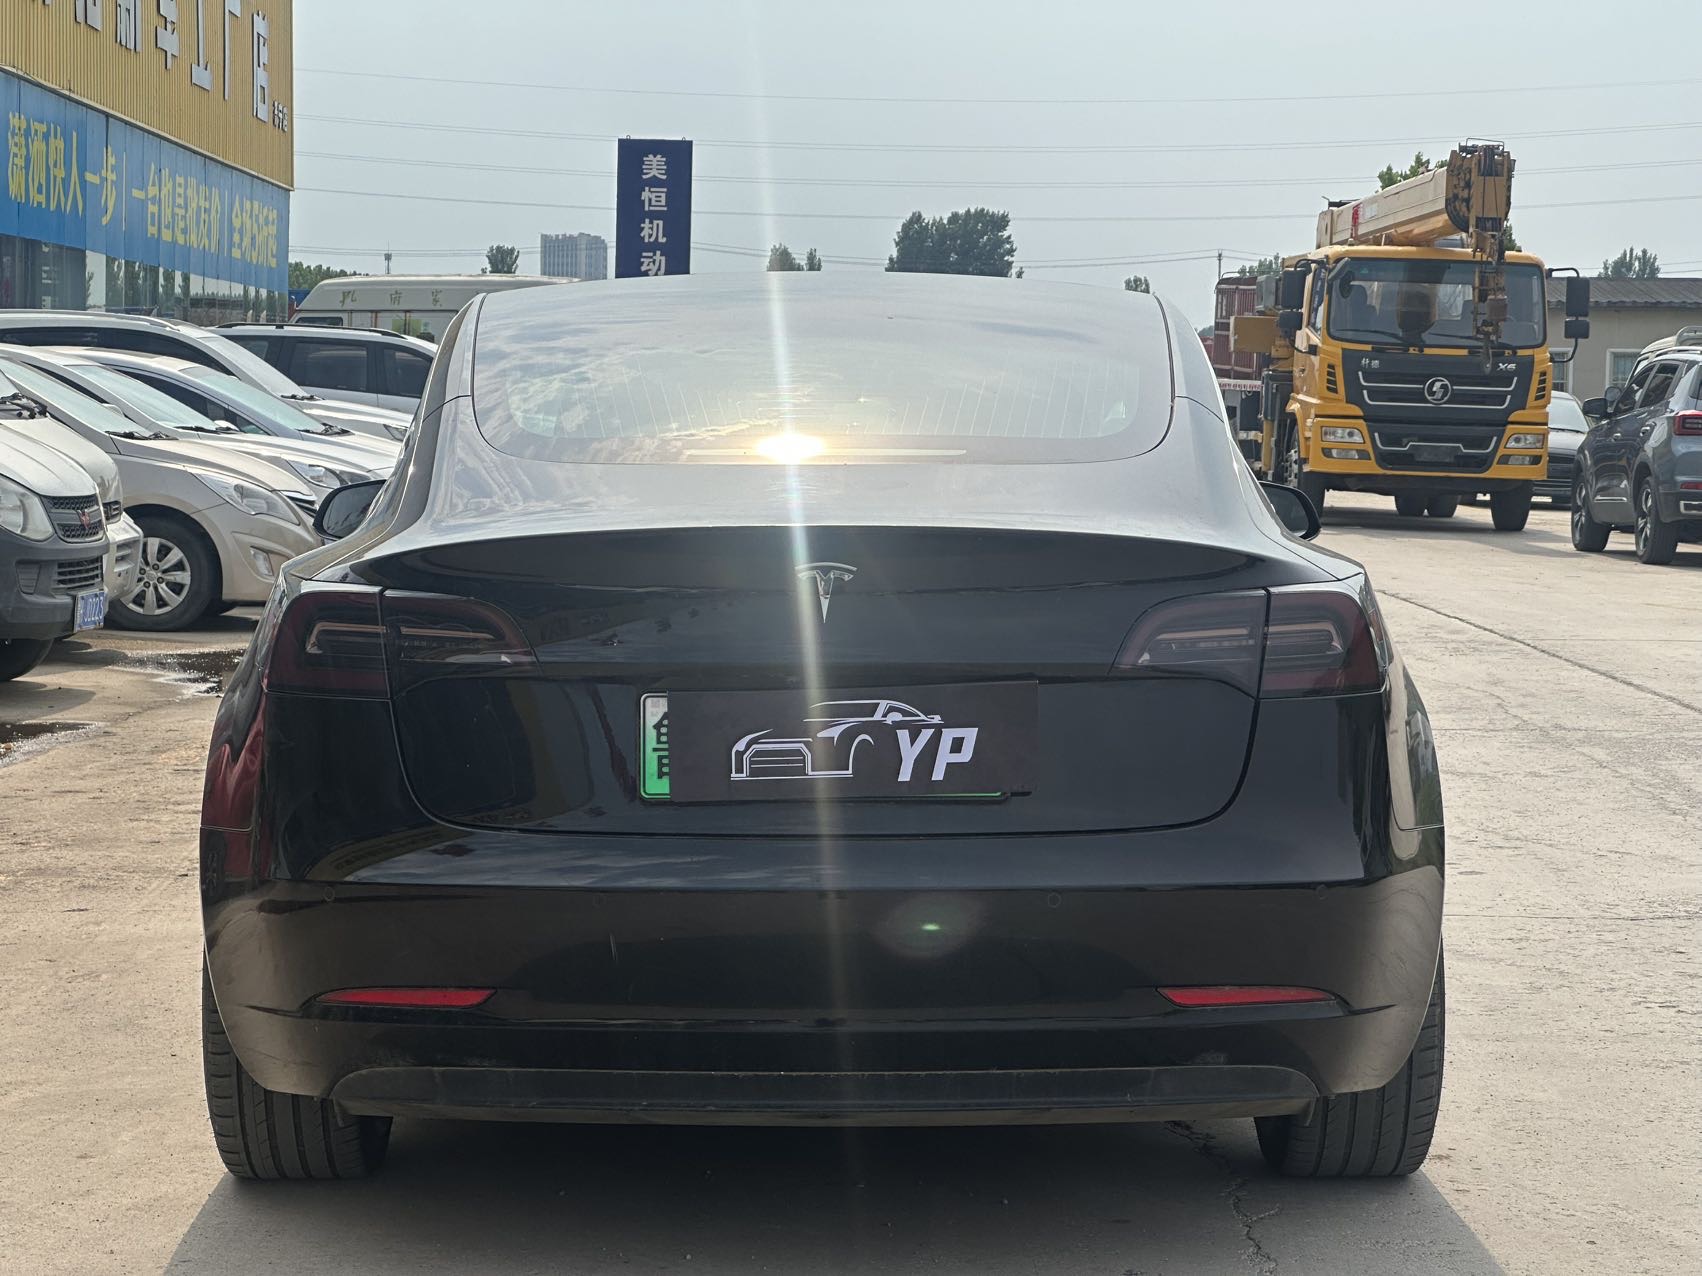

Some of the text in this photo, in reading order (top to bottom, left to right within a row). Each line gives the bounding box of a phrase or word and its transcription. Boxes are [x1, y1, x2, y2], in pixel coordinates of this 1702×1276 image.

[8, 111, 117, 226] 潇洒快人一步
[131, 161, 221, 254] 一台也是批发价
[640, 154, 667, 276] 美恒机动
[1496, 363, 1517, 372] X6
[896, 727, 979, 782] YP
